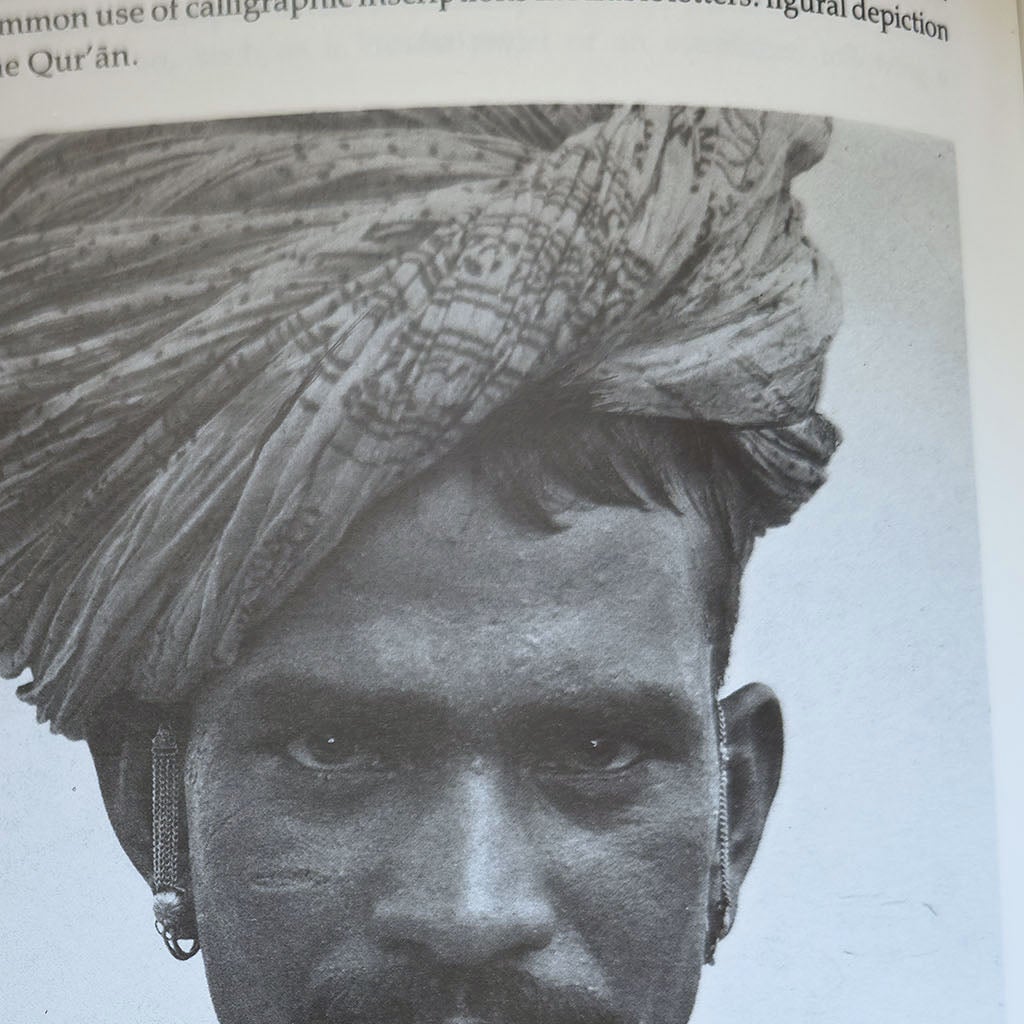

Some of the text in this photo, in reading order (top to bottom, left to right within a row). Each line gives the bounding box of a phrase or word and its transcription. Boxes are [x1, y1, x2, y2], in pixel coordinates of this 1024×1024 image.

[96, 6, 144, 26] use
[151, 0, 178, 22] of
[852, 0, 948, 42] depiction
